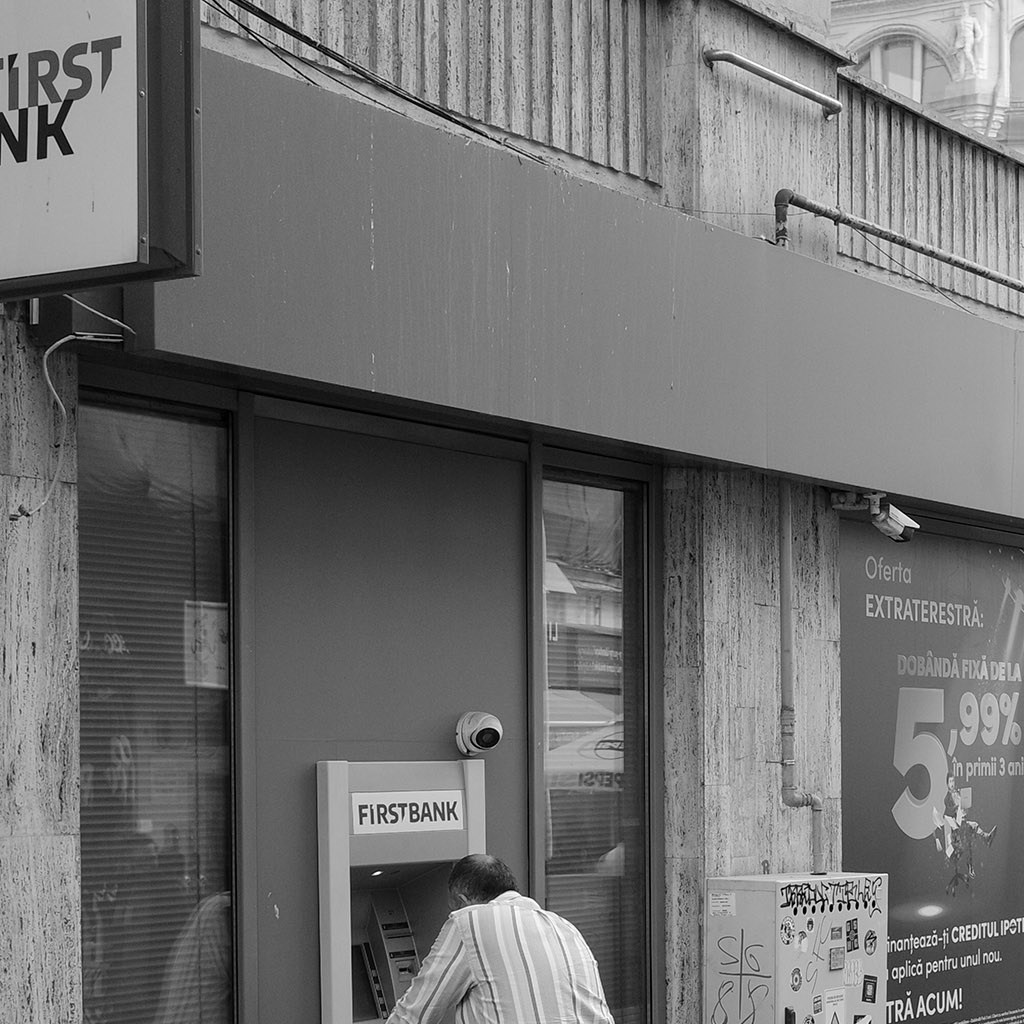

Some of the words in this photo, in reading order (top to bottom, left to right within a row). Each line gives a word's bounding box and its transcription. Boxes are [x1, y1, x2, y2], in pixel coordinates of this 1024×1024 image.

[0, 35, 122, 111] IRST
[865, 555, 911, 584] Oferta
[865, 594, 984, 628] EXTRATERESTRĂ:
[897, 650, 960, 679] DOBÂNDĂ
[962, 655, 989, 681] FIXĂ
[990, 660, 1006, 681] DE
[1007, 662, 1022, 682] LA
[952, 756, 963, 777] în
[966, 756, 997, 782] primii
[999, 757, 1006, 777] 3
[358, 801, 459, 825] FIRSTBANK
[887, 928, 949, 955] inanțează-ți
[951, 921, 999, 944] CREDITUL
[891, 959, 923, 984] aplică
[926, 955, 958, 979] pentru
[960, 949, 981, 967] unul
[982, 950, 1003, 964] nou.
[886, 990, 914, 1024] TRĂ
[916, 987, 963, 1018] ACUM!
